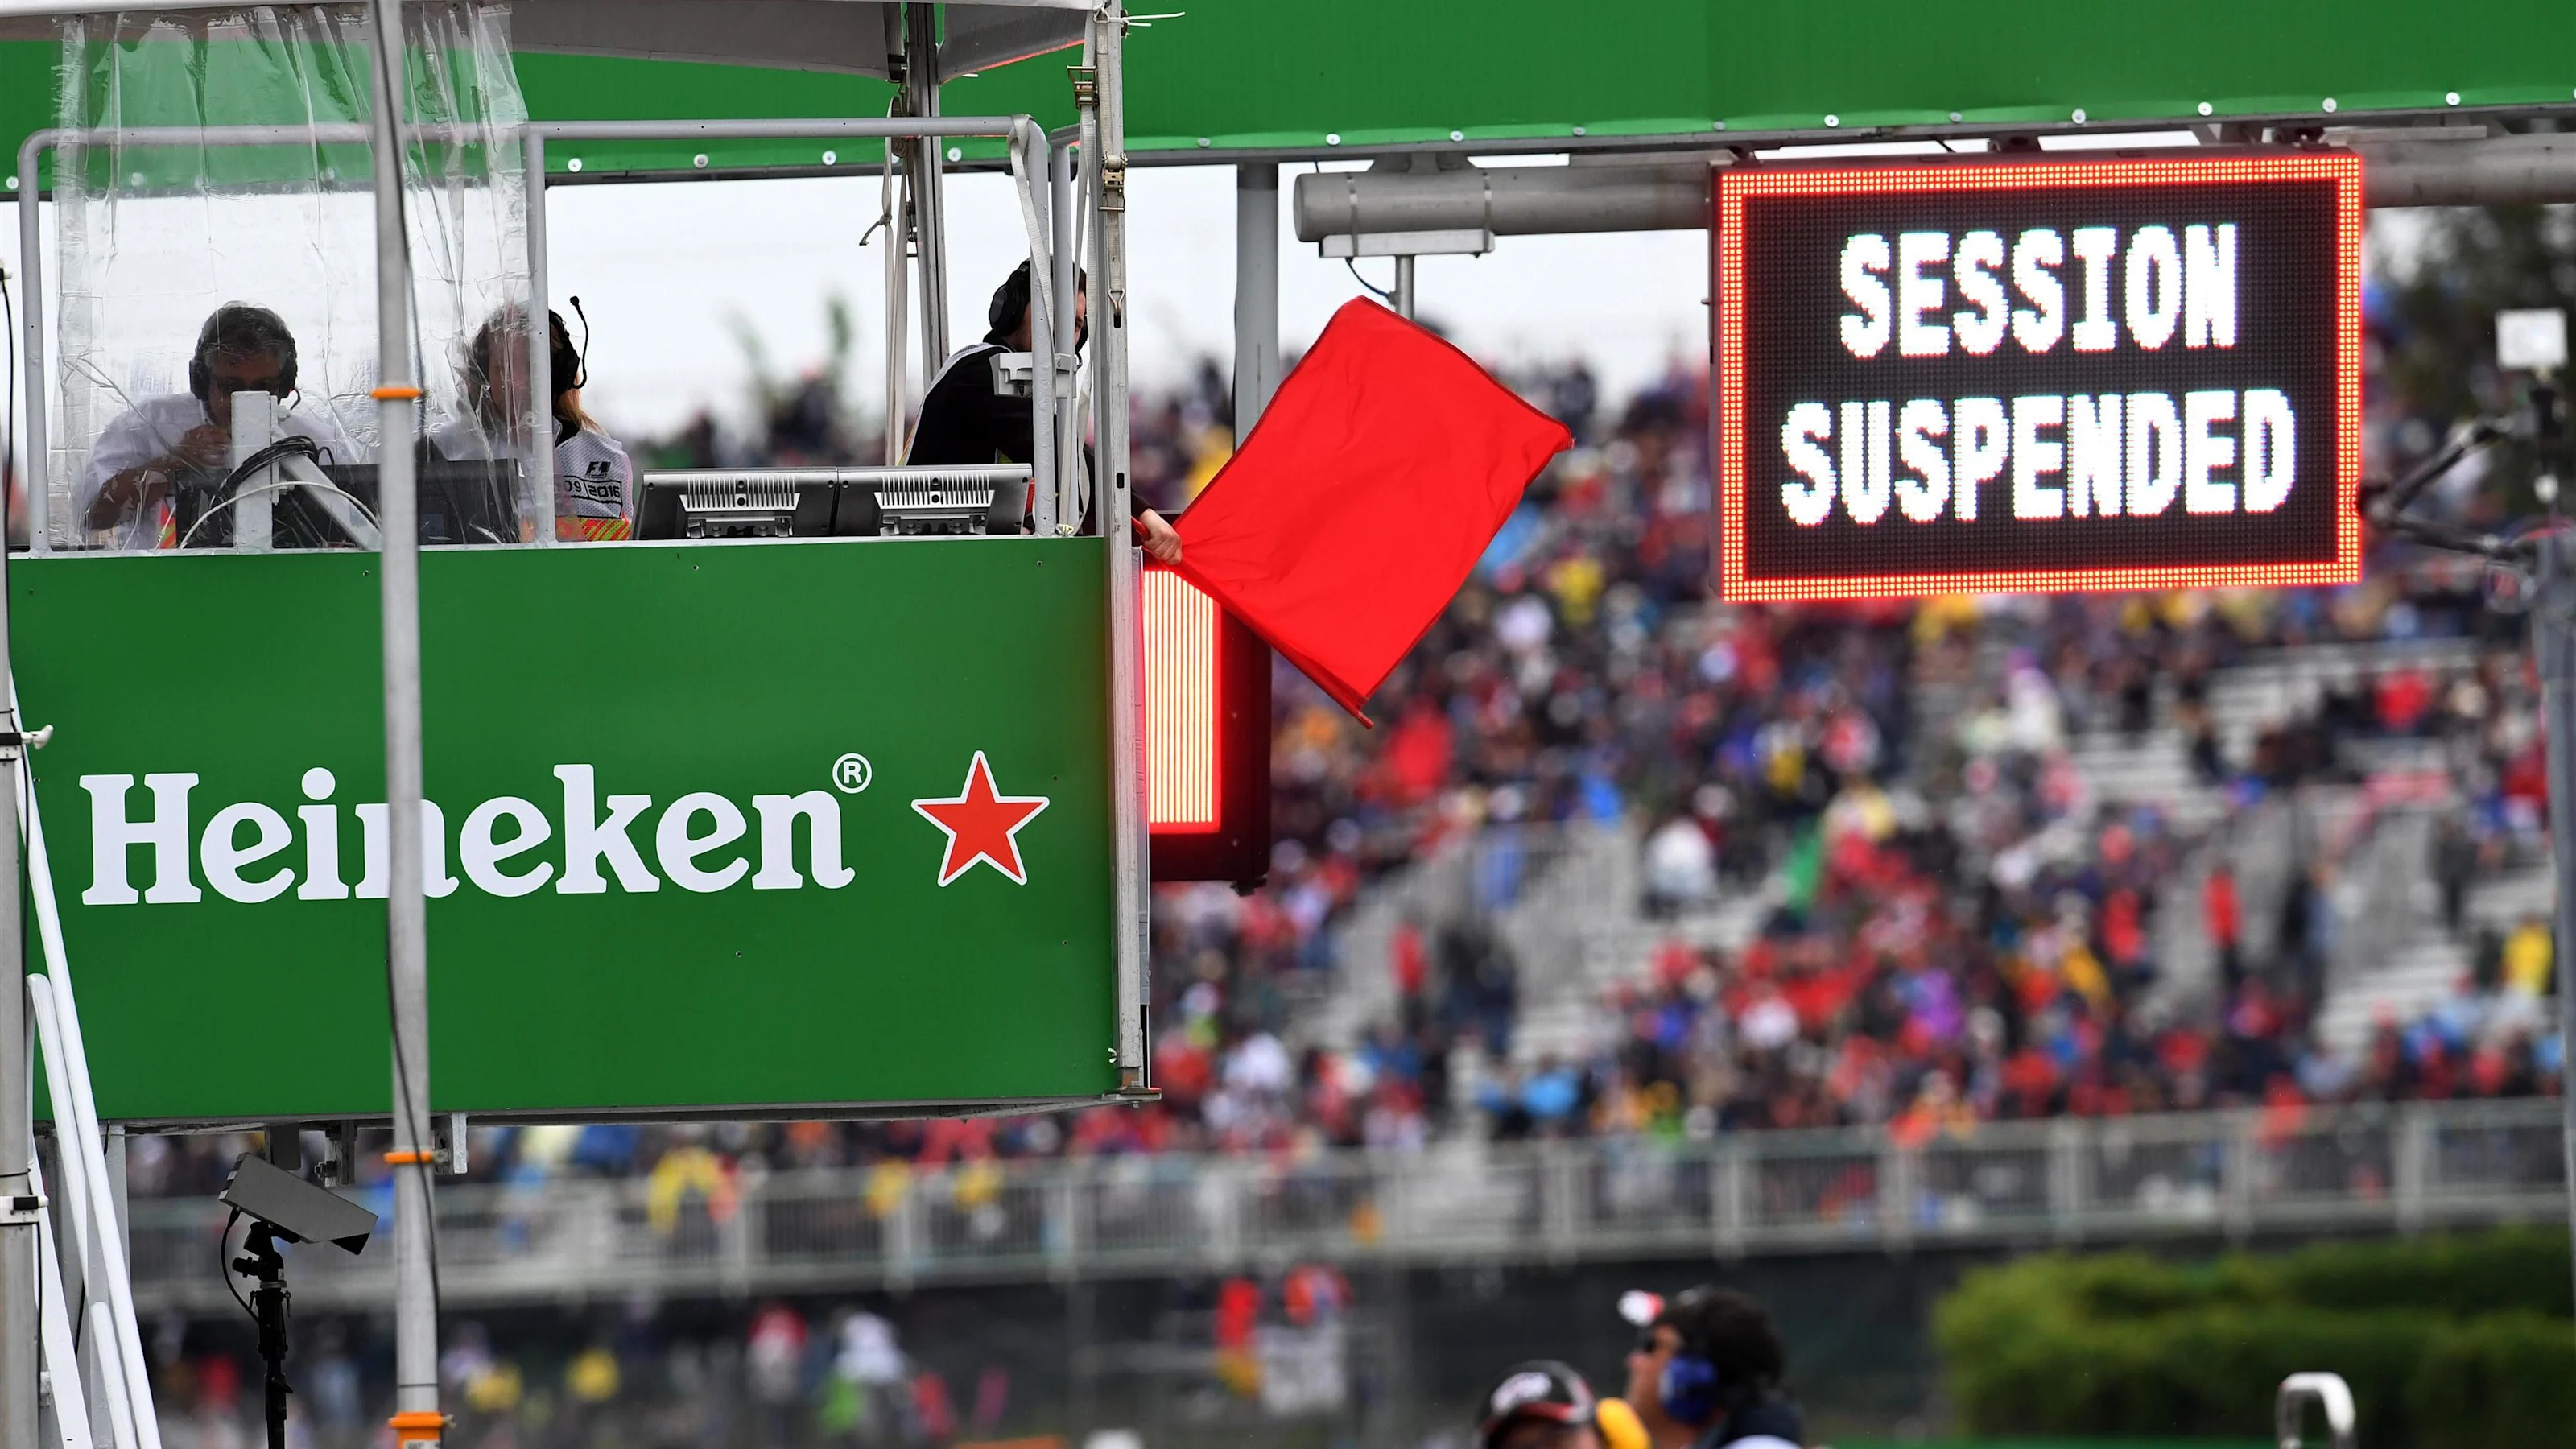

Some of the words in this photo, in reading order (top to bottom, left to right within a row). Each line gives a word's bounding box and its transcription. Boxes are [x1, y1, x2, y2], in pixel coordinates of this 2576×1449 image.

[1840, 223, 2238, 358] SESSION
[588, 485, 621, 498] 2016
[1781, 388, 2297, 526] SUSPENDED
[79, 763, 856, 905] Heineken
